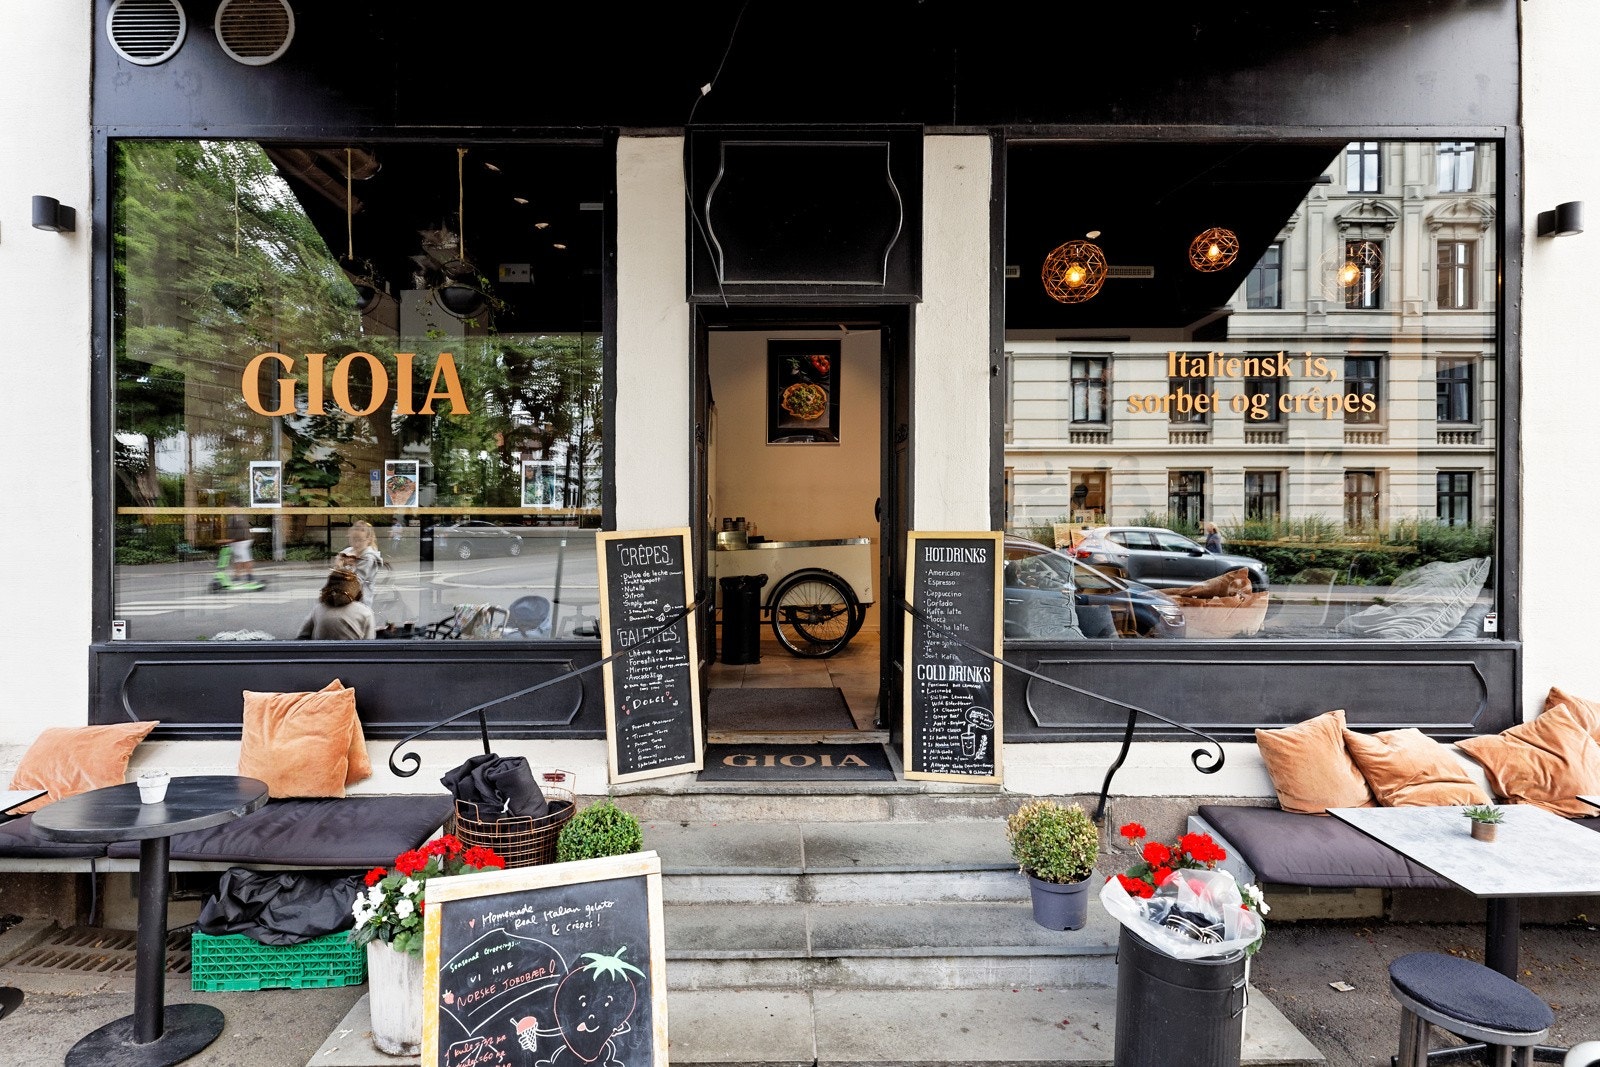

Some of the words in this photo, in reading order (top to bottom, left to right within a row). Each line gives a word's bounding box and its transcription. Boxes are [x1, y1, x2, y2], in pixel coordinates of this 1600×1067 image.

[1167, 351, 1293, 377] Italiensk
[1304, 351, 1338, 382] is,
[241, 352, 471, 416] GIOIA
[1127, 387, 1219, 413] sorbet
[1232, 393, 1269, 420] og
[1278, 386, 1377, 419] crêpes
[620, 544, 670, 567] CRÊPES
[925, 547, 945, 562] HOT
[946, 547, 987, 563] DRINKS
[928, 569, 961, 577] Americano
[928, 578, 956, 587] Espresso
[926, 589, 962, 598] Cappuccino
[926, 599, 953, 607] Cortado
[917, 664, 946, 680] COLD
[948, 665, 991, 683] DRINKS
[722, 754, 870, 767] GIOIA
[482, 904, 533, 924] Homemade
[515, 915, 538, 930] Real
[544, 906, 581, 921] Italian
[585, 901, 615, 919] gelato
[552, 924, 560, 936] &
[450, 951, 480, 973] Seasonal
[470, 974, 481, 983] VI
[492, 961, 514, 975] HAR
[456, 984, 497, 1011] NORSKE
